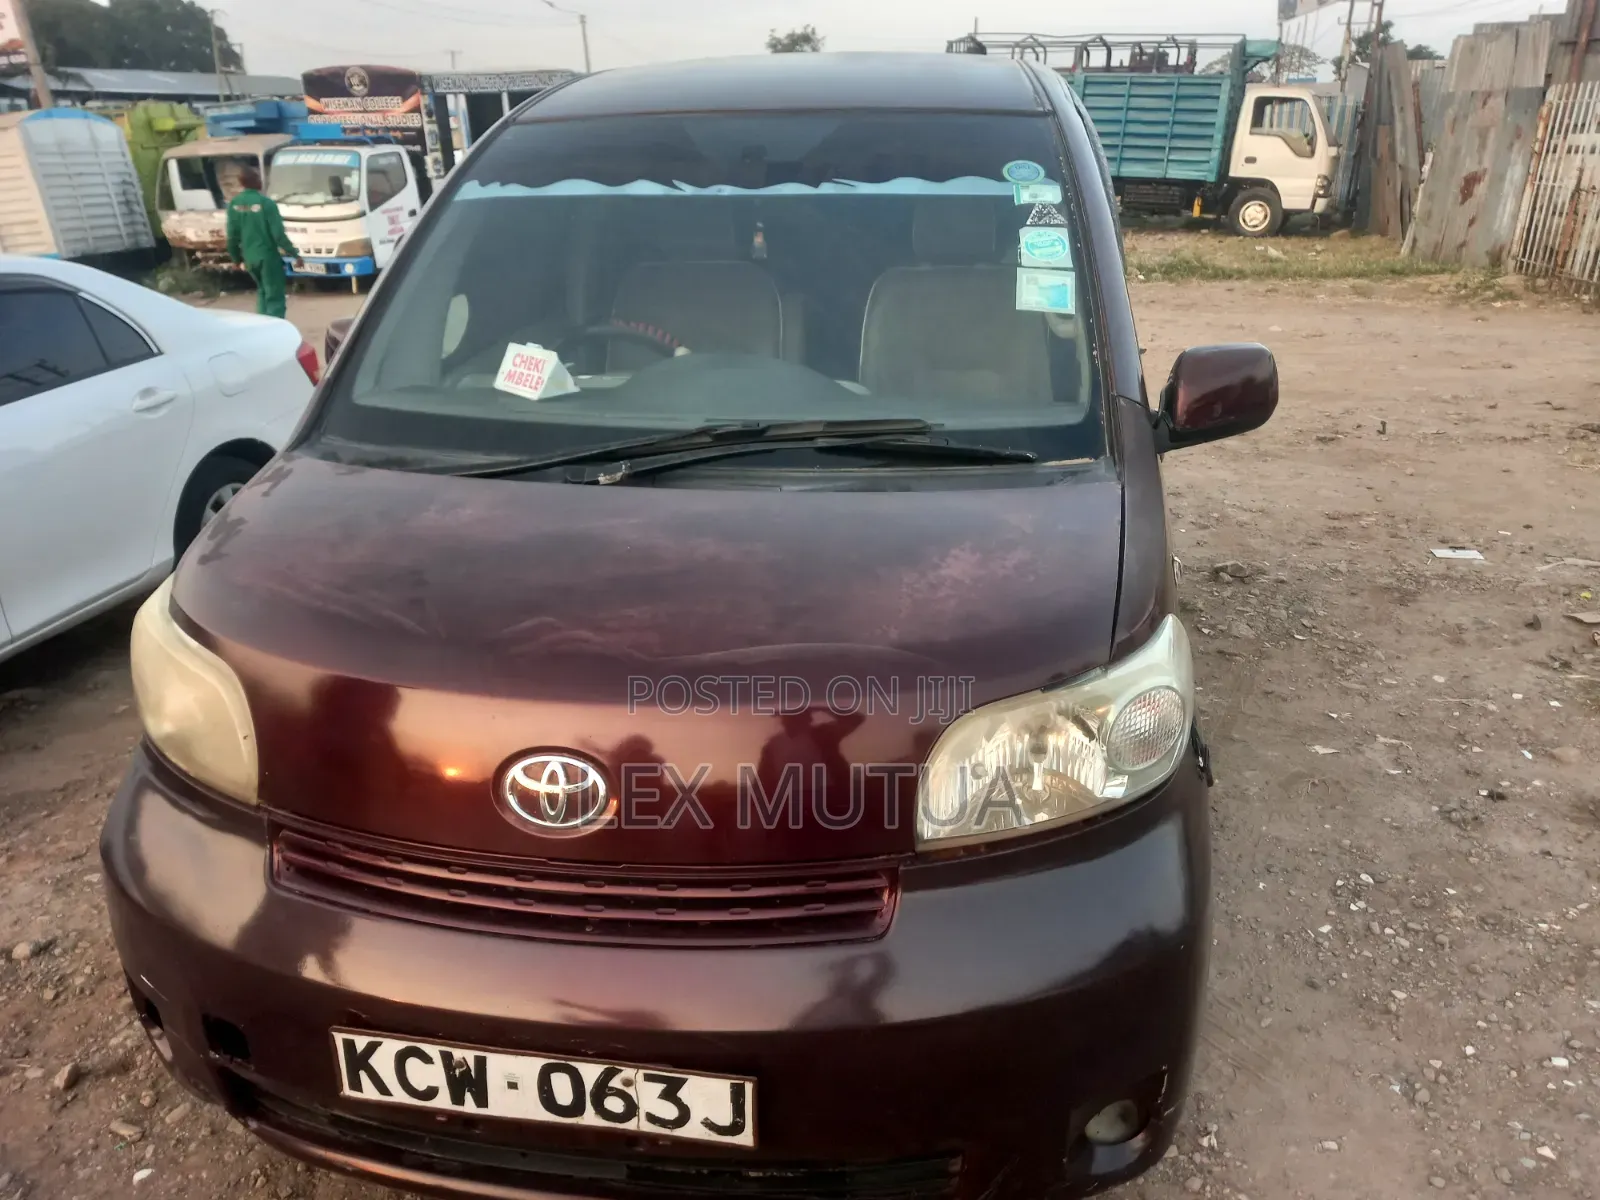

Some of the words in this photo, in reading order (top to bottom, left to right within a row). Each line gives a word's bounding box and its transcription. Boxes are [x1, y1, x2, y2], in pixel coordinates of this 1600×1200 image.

[320, 97, 363, 110] WISEMAN
[363, 96, 402, 110] COLLEGE
[322, 114, 384, 127] PROFESSIONAL
[384, 113, 421, 127] STUDIES
[512, 353, 546, 374] CHEKI
[341, 1038, 489, 1109] KCW
